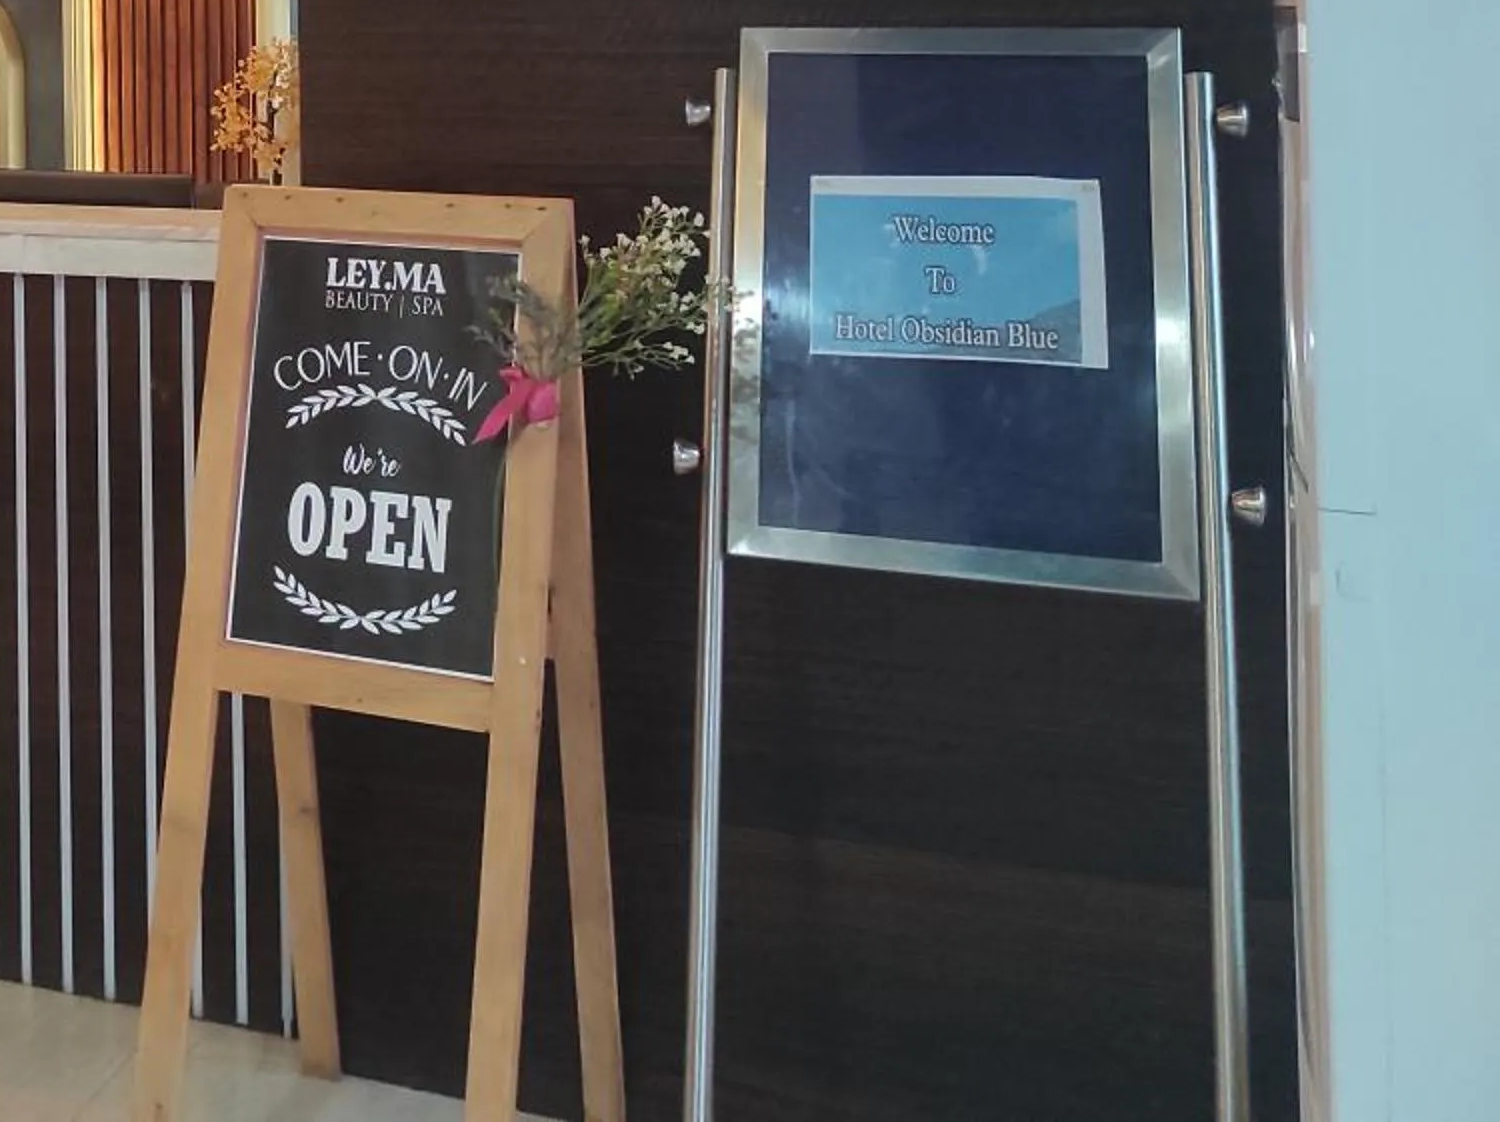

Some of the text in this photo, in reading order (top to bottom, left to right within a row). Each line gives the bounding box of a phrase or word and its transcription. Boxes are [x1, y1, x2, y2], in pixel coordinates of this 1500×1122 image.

[891, 215, 996, 244] Welcome
[326, 257, 446, 295] LEY.MA
[925, 266, 956, 294] To
[325, 289, 444, 317] BEAUTY SPA
[835, 314, 1059, 350] Hotel Obsidian Blue
[273, 341, 489, 412] COME ON IN
[343, 443, 399, 478] We're
[287, 481, 452, 573] OPEN
